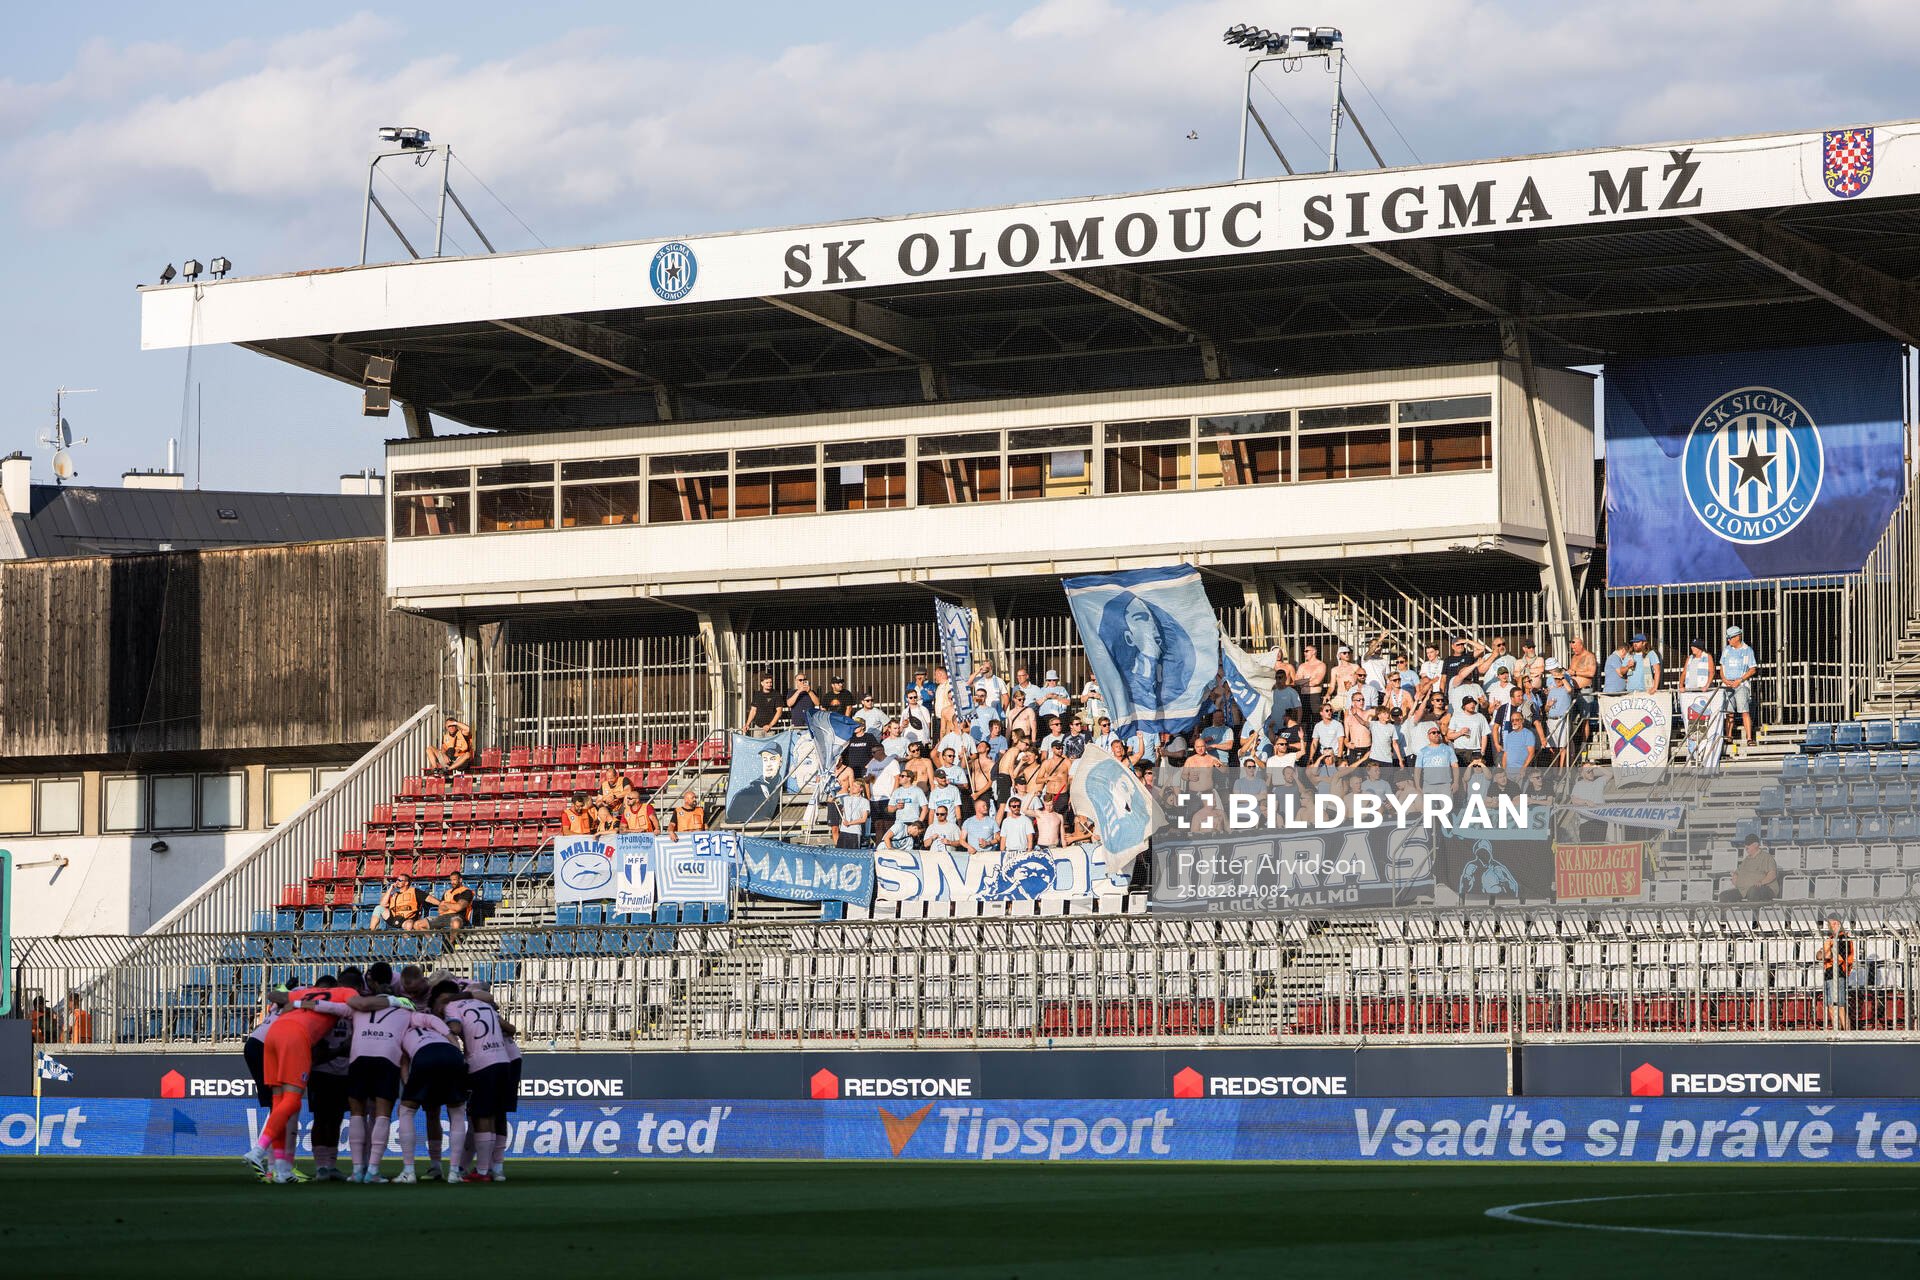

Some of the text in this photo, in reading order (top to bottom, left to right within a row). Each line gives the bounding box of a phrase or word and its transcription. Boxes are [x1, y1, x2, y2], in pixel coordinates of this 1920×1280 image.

[783, 148, 1703, 289] SK OLOMOUC SIGMA MŽ
[655, 243, 690, 261] SK SIGMA
[655, 282, 692, 300] OLOMOUC
[1703, 394, 1799, 433] SK SIGMA
[1703, 496, 1806, 538] OLOMOUC
[678, 862, 705, 874] 1910
[740, 849, 863, 892] MALMØ
[1154, 824, 1432, 902] ULTRAS
[1560, 847, 1638, 871] SKÅNELAGET
[790, 887, 814, 899] 1910
[1560, 871, 1619, 896] I EUROPA
[618, 890, 652, 906] Framtid
[1284, 885, 1359, 909] MALMÖ
[463, 1007, 495, 1039] 37
[190, 1079, 258, 1096] REDST
[844, 1078, 972, 1097] REDSTONE
[1209, 1076, 1348, 1096] REDSTONE
[1670, 1073, 1821, 1094] REDSTONE
[637, 1106, 732, 1155] teď
[939, 1106, 1174, 1161] Tipsport
[1353, 1105, 1920, 1162] Vsaďte si právě te
